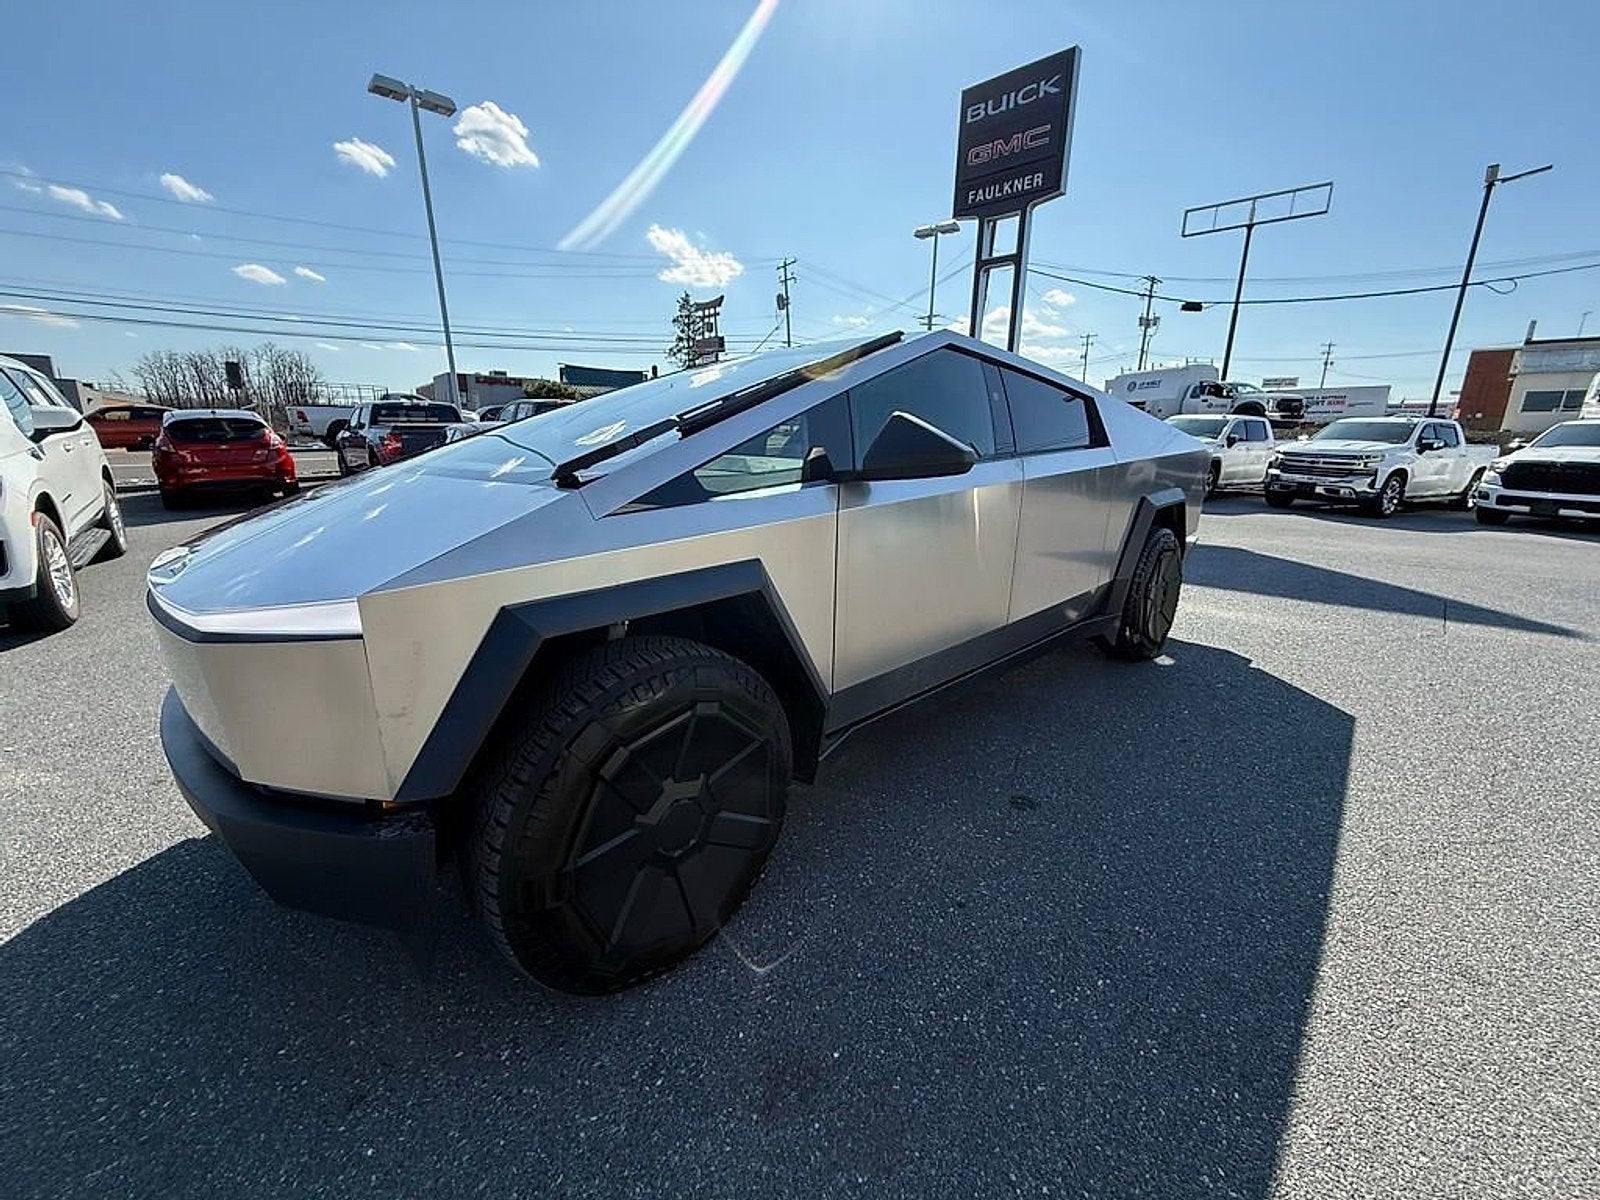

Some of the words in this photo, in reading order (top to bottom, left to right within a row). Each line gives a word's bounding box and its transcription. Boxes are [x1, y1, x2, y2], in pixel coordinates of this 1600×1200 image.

[966, 74, 1061, 123] BUICK
[967, 124, 1051, 165] GMC
[968, 173, 1043, 204] FAULKNER
